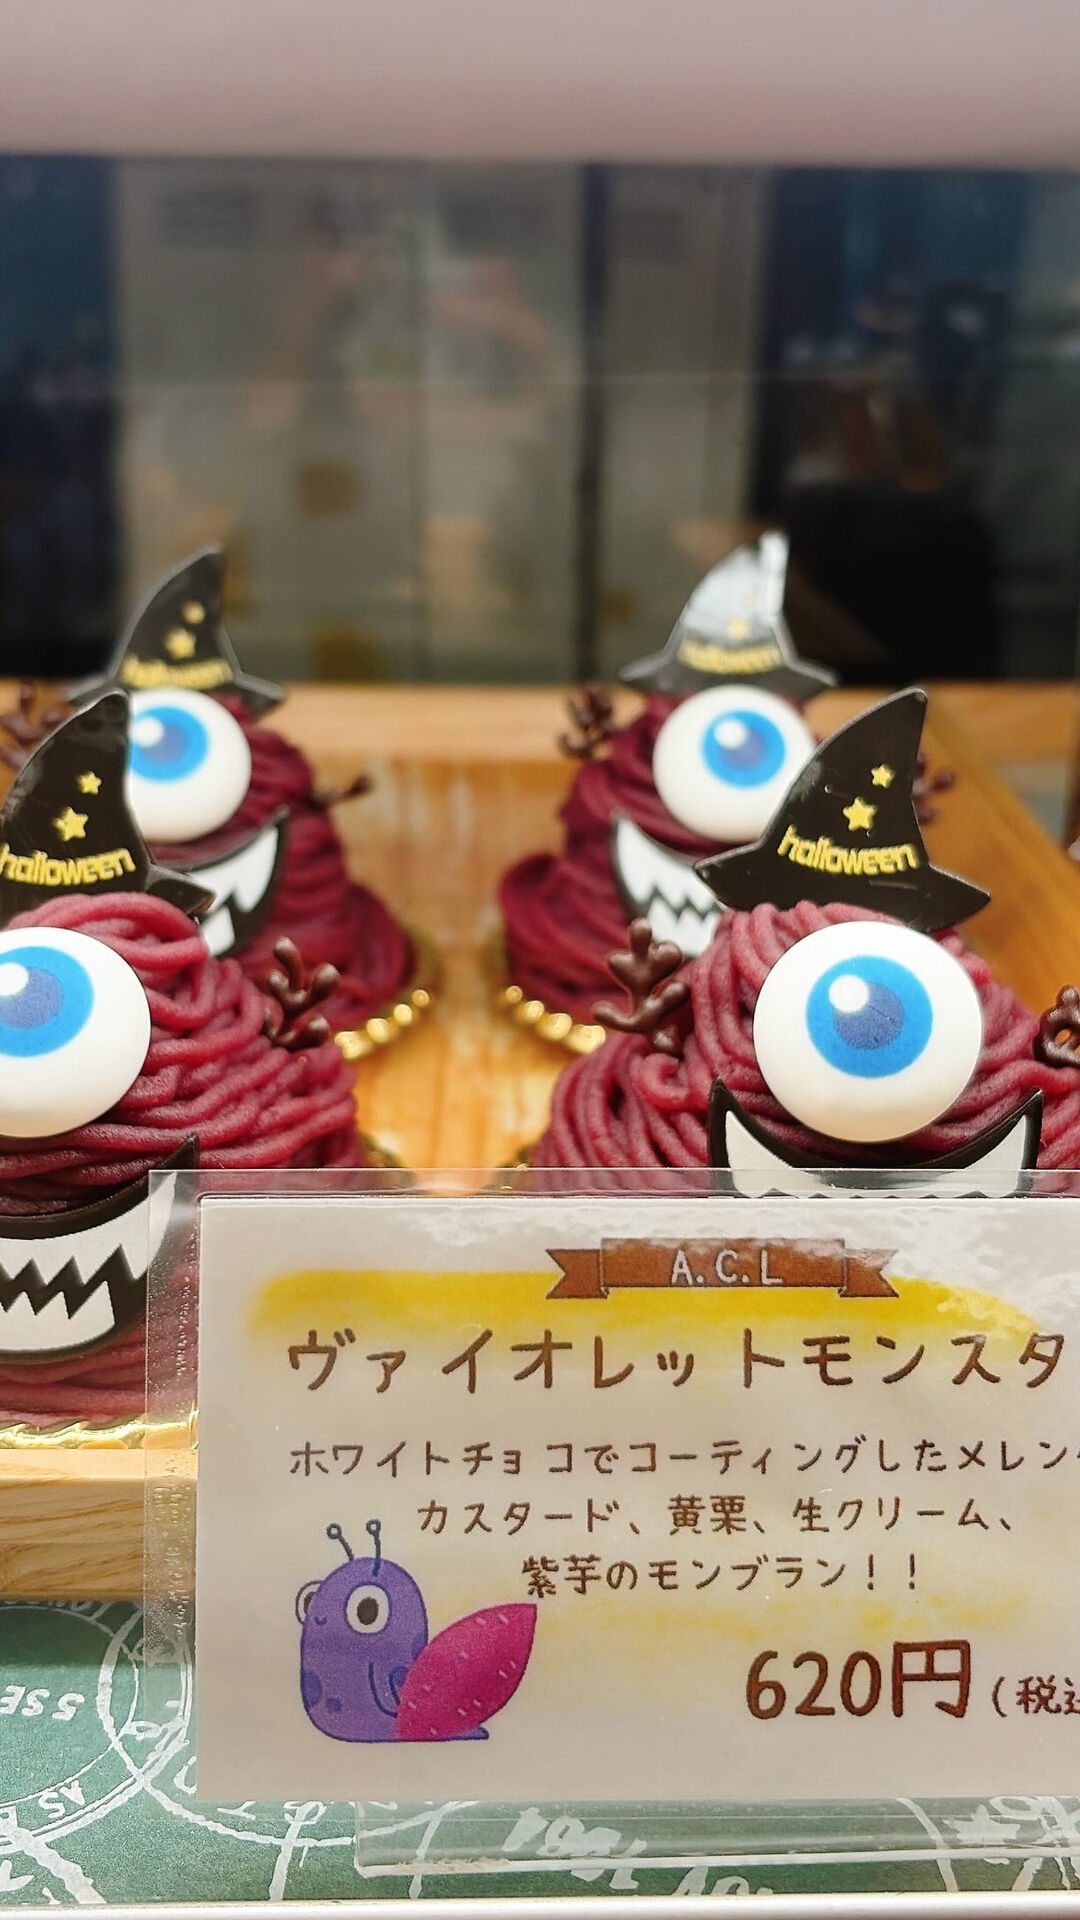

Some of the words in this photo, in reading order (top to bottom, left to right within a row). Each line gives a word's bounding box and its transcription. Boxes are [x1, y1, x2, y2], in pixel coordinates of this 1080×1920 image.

[0, 842, 136, 886] halloween
[777, 824, 920, 876] halloween
[671, 1248, 783, 1286] A.C.L
[288, 1328, 1065, 1393] ヴァイオレットモンスタ
[289, 1434, 1080, 1478] ホワイトチョコでコーティングしたメレン
[746, 1639, 971, 1720] 620円
